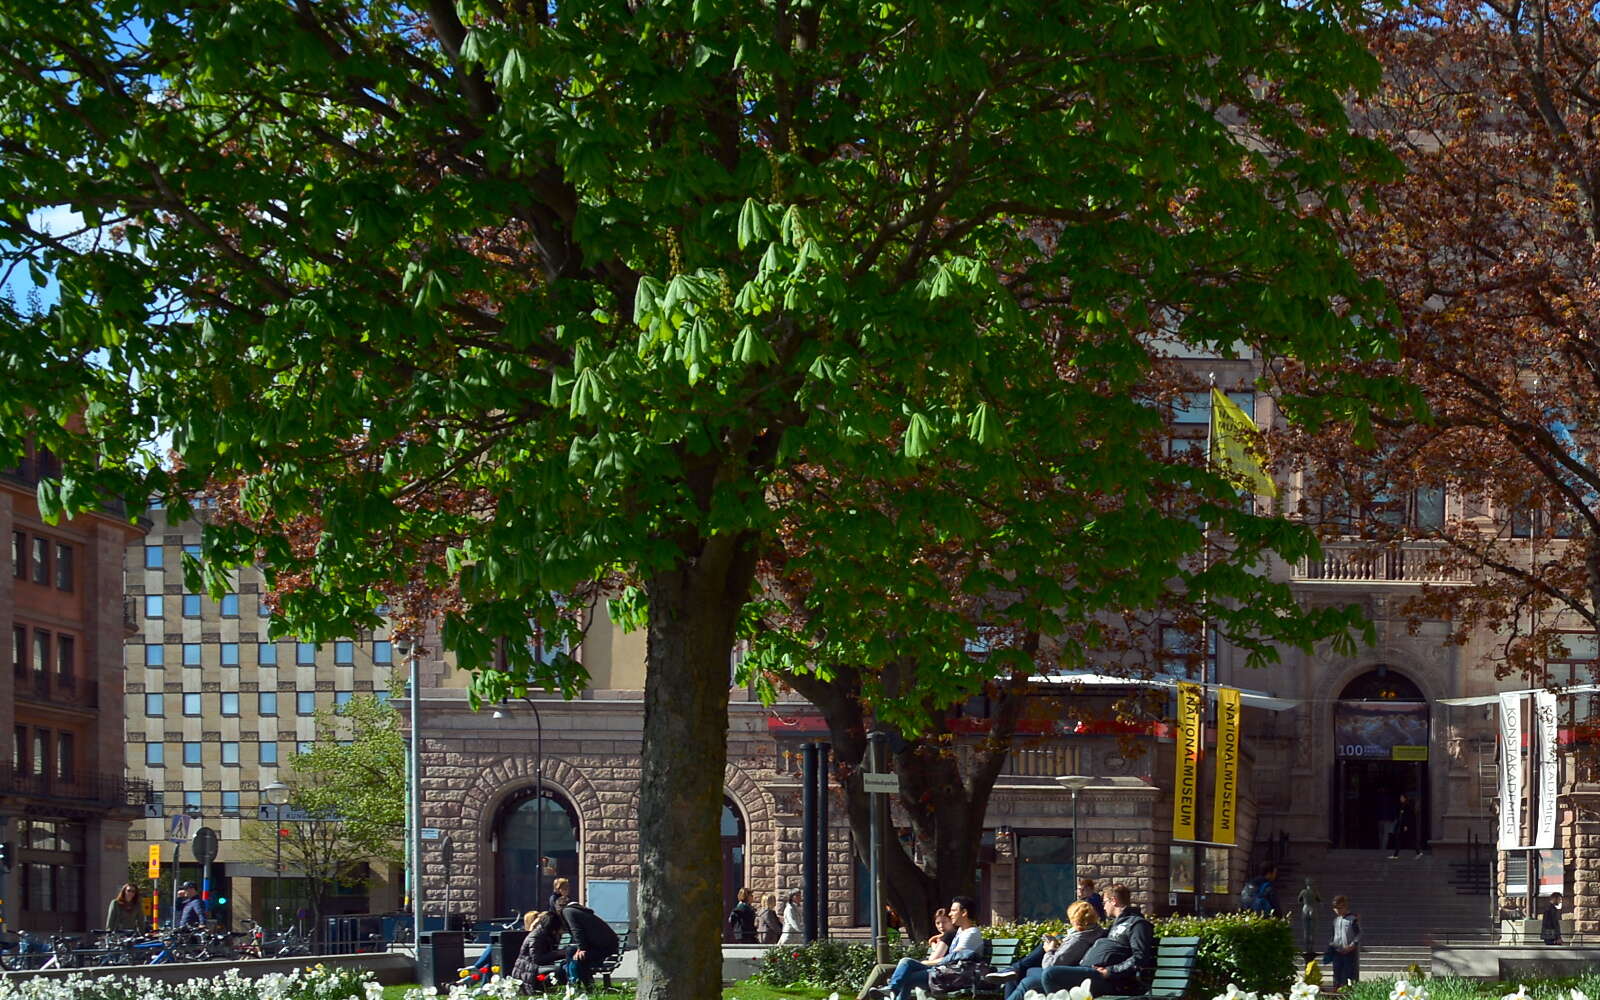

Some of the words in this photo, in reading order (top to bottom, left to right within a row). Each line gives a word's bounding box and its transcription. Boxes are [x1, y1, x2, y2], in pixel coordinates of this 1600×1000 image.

[1180, 696, 1195, 826] NATIONALMUSEUM
[1221, 702, 1235, 830] NATIONALMUSEUM
[1339, 744, 1363, 756] 100
[1506, 707, 1517, 834] KONSTAKADEMIEN
